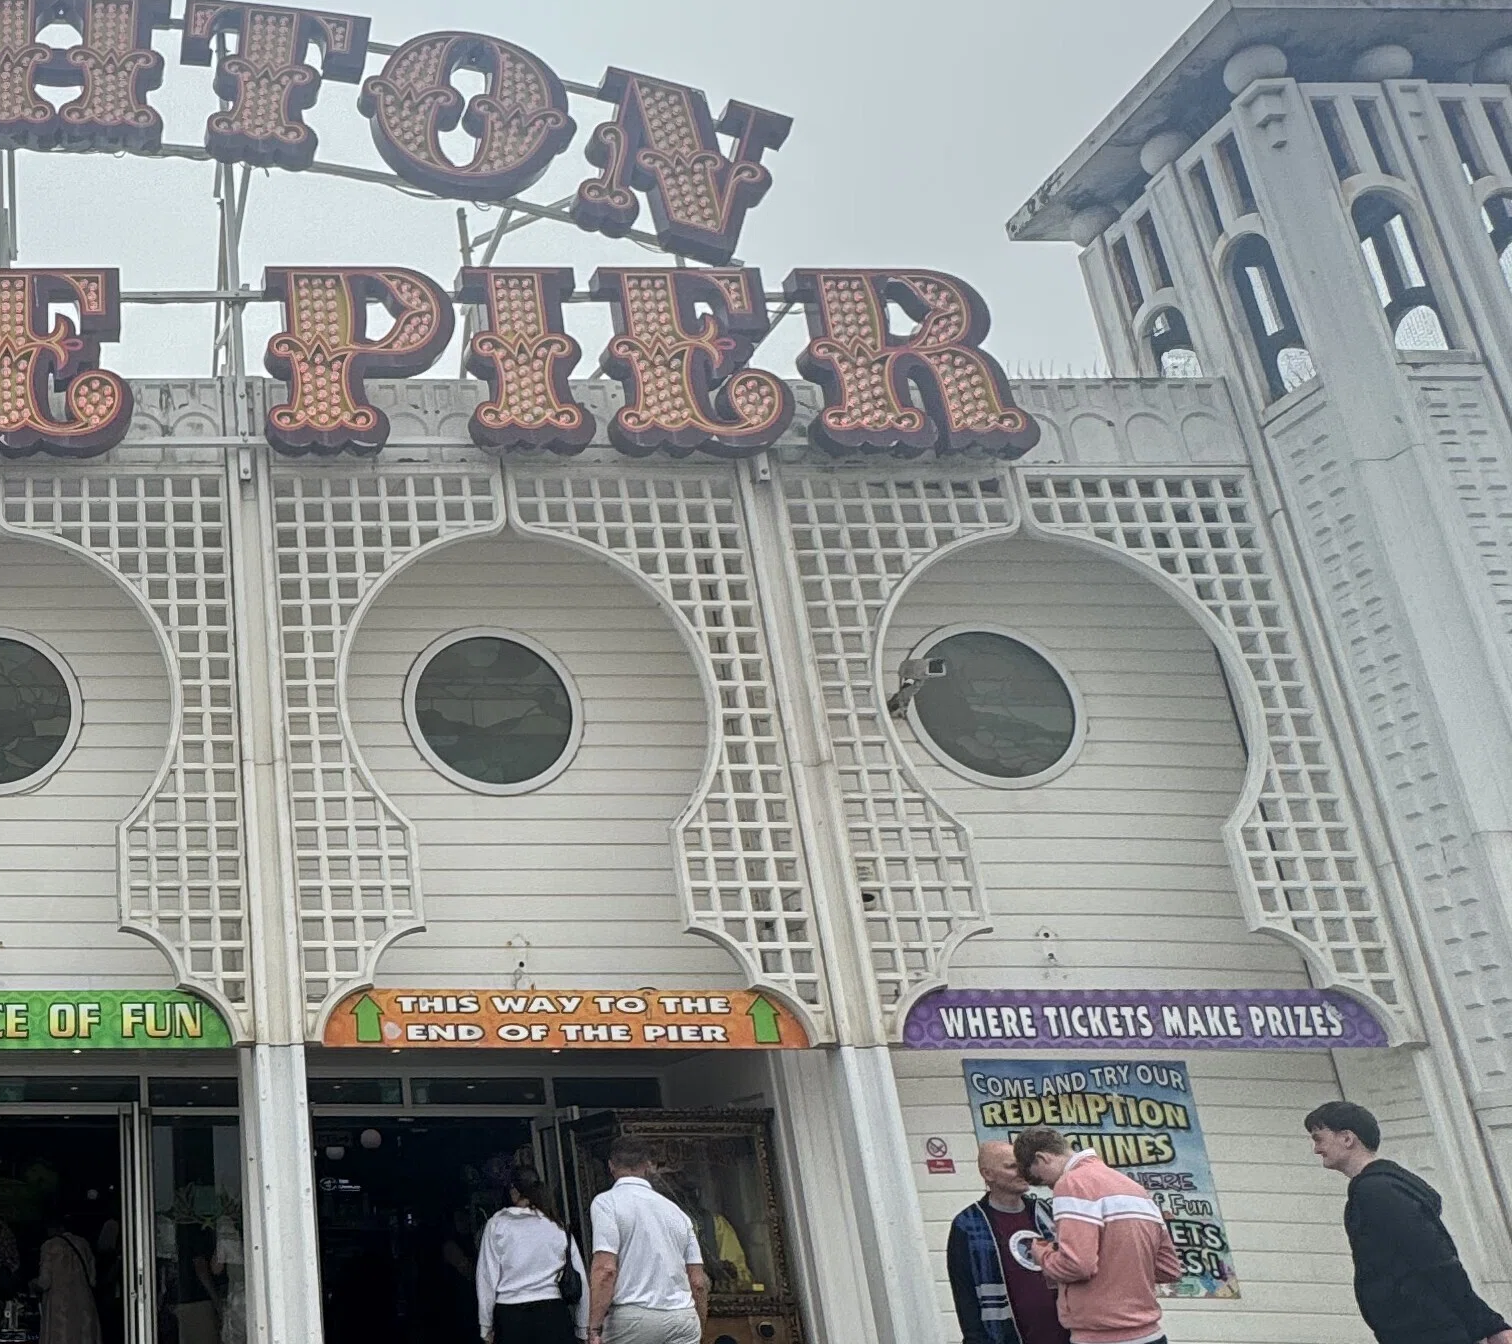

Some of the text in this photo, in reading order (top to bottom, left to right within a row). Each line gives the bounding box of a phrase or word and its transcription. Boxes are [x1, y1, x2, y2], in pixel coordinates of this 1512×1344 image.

[262, 266, 1041, 459] PIER
[49, 1003, 101, 1040] OF
[122, 1002, 203, 1039] FUN
[396, 996, 731, 1014] THIS WAY TO THE
[939, 1004, 1345, 1039] WHERE TICKETS MAKE PRIZES
[406, 1024, 729, 1043] END OF THE PIER
[971, 1064, 1186, 1099] COME AND TRY OUR
[981, 1093, 1190, 1129] REDEMPTION
[1169, 1193, 1213, 1216] Fun
